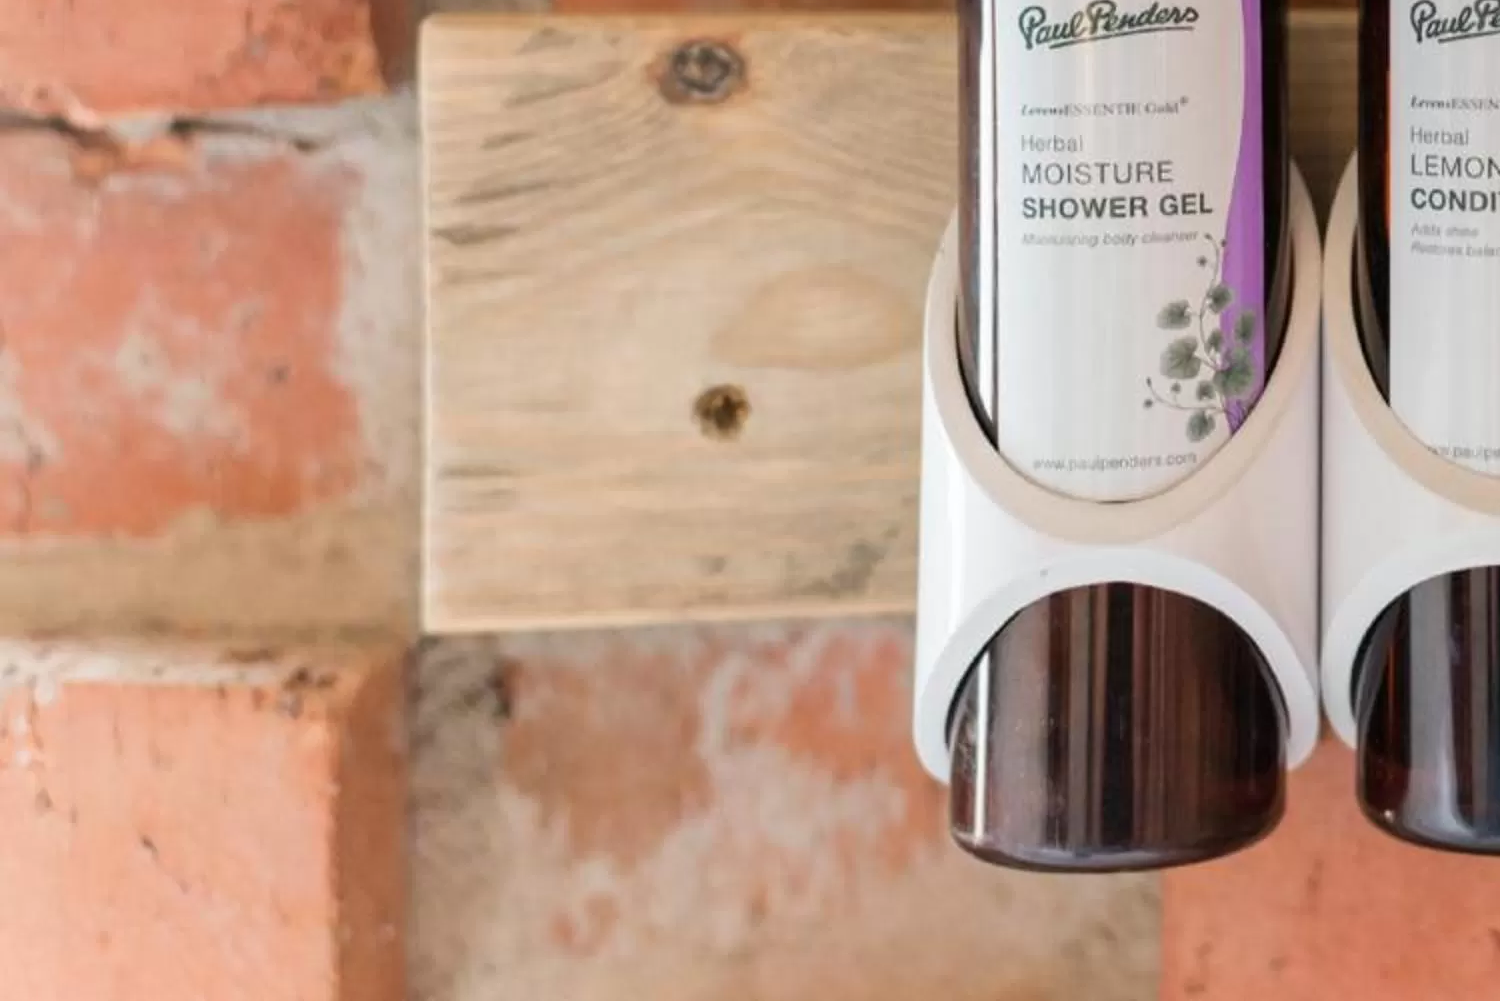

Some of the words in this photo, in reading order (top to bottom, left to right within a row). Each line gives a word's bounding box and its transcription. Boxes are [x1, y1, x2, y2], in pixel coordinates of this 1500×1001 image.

[1019, 5, 1087, 50] Paul
[1086, 0, 1199, 36] Penders
[1021, 134, 1083, 152] Herbal
[1410, 125, 1469, 146] Herbal
[1021, 160, 1174, 186] MOISTURE
[1022, 195, 1149, 219] SHOWER
[1159, 192, 1213, 216] GEL
[1102, 233, 1138, 247] body
